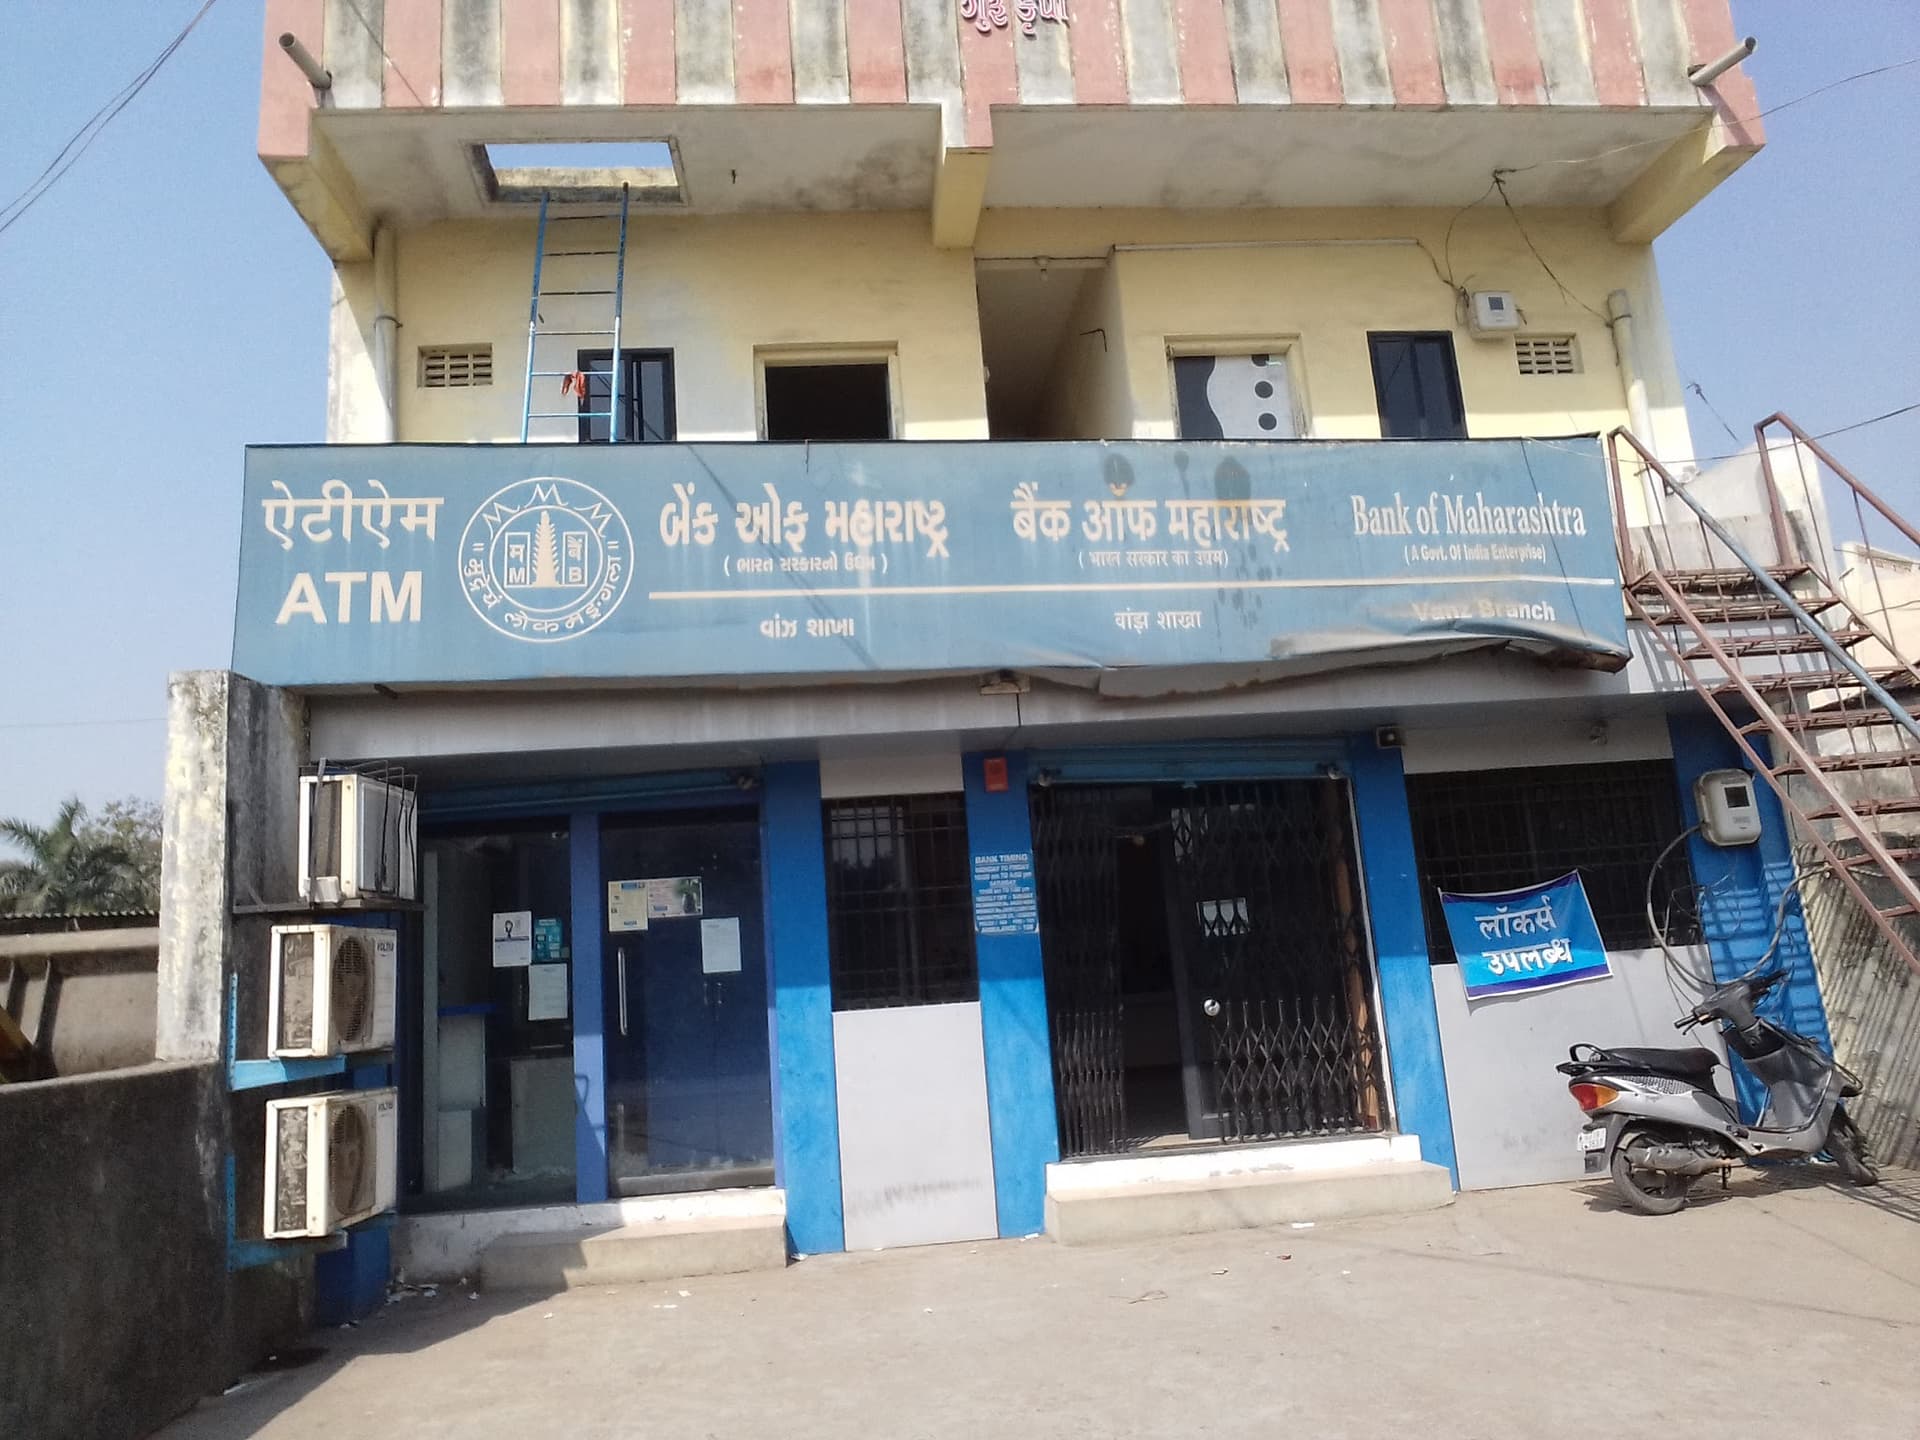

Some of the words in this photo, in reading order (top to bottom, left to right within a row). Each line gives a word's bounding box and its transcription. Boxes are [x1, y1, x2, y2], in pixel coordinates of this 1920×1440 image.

[261, 480, 444, 550] ऐटीऐम
[660, 482, 719, 546] બેંક
[1010, 481, 1072, 543] बैंक
[1164, 499, 1290, 553] महाराष्ट्र
[1351, 492, 1413, 536] Bank
[1416, 491, 1438, 535] of
[1441, 491, 1587, 536] Maharashtra
[1420, 545, 1447, 561] Govt.
[1449, 544, 1461, 560] Of
[1464, 544, 1489, 561] India
[275, 571, 423, 625] ATM
[1477, 601, 1556, 622] Branch
[1474, 895, 1557, 940] लॉकर्स
[1481, 938, 1574, 975] उपलब्ध
